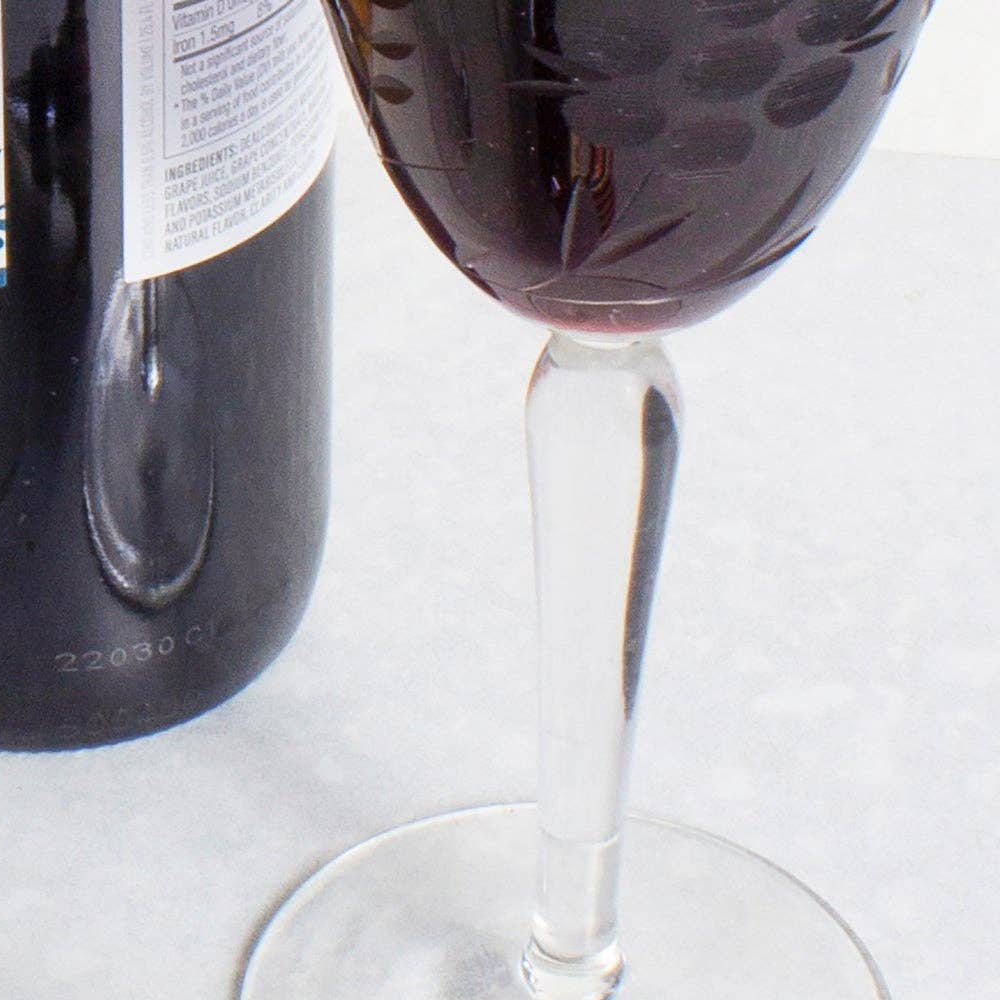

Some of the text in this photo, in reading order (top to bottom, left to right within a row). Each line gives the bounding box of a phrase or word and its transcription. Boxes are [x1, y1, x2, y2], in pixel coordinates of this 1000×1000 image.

[172, 5, 214, 30] Vitamin
[172, 35, 195, 54] Iron
[200, 20, 236, 41] 1.5mg
[182, 95, 198, 112] The
[211, 83, 232, 102] Daily
[200, 102, 231, 123] serving
[181, 128, 207, 149] 2,000
[208, 115, 239, 137] calories
[165, 144, 238, 182] INGREDIENTS:
[164, 176, 198, 201] GRAPE
[165, 193, 242, 234] AND POTASSIUM
[165, 226, 209, 252] NATURAL
[55, 635, 176, 673] 22030
